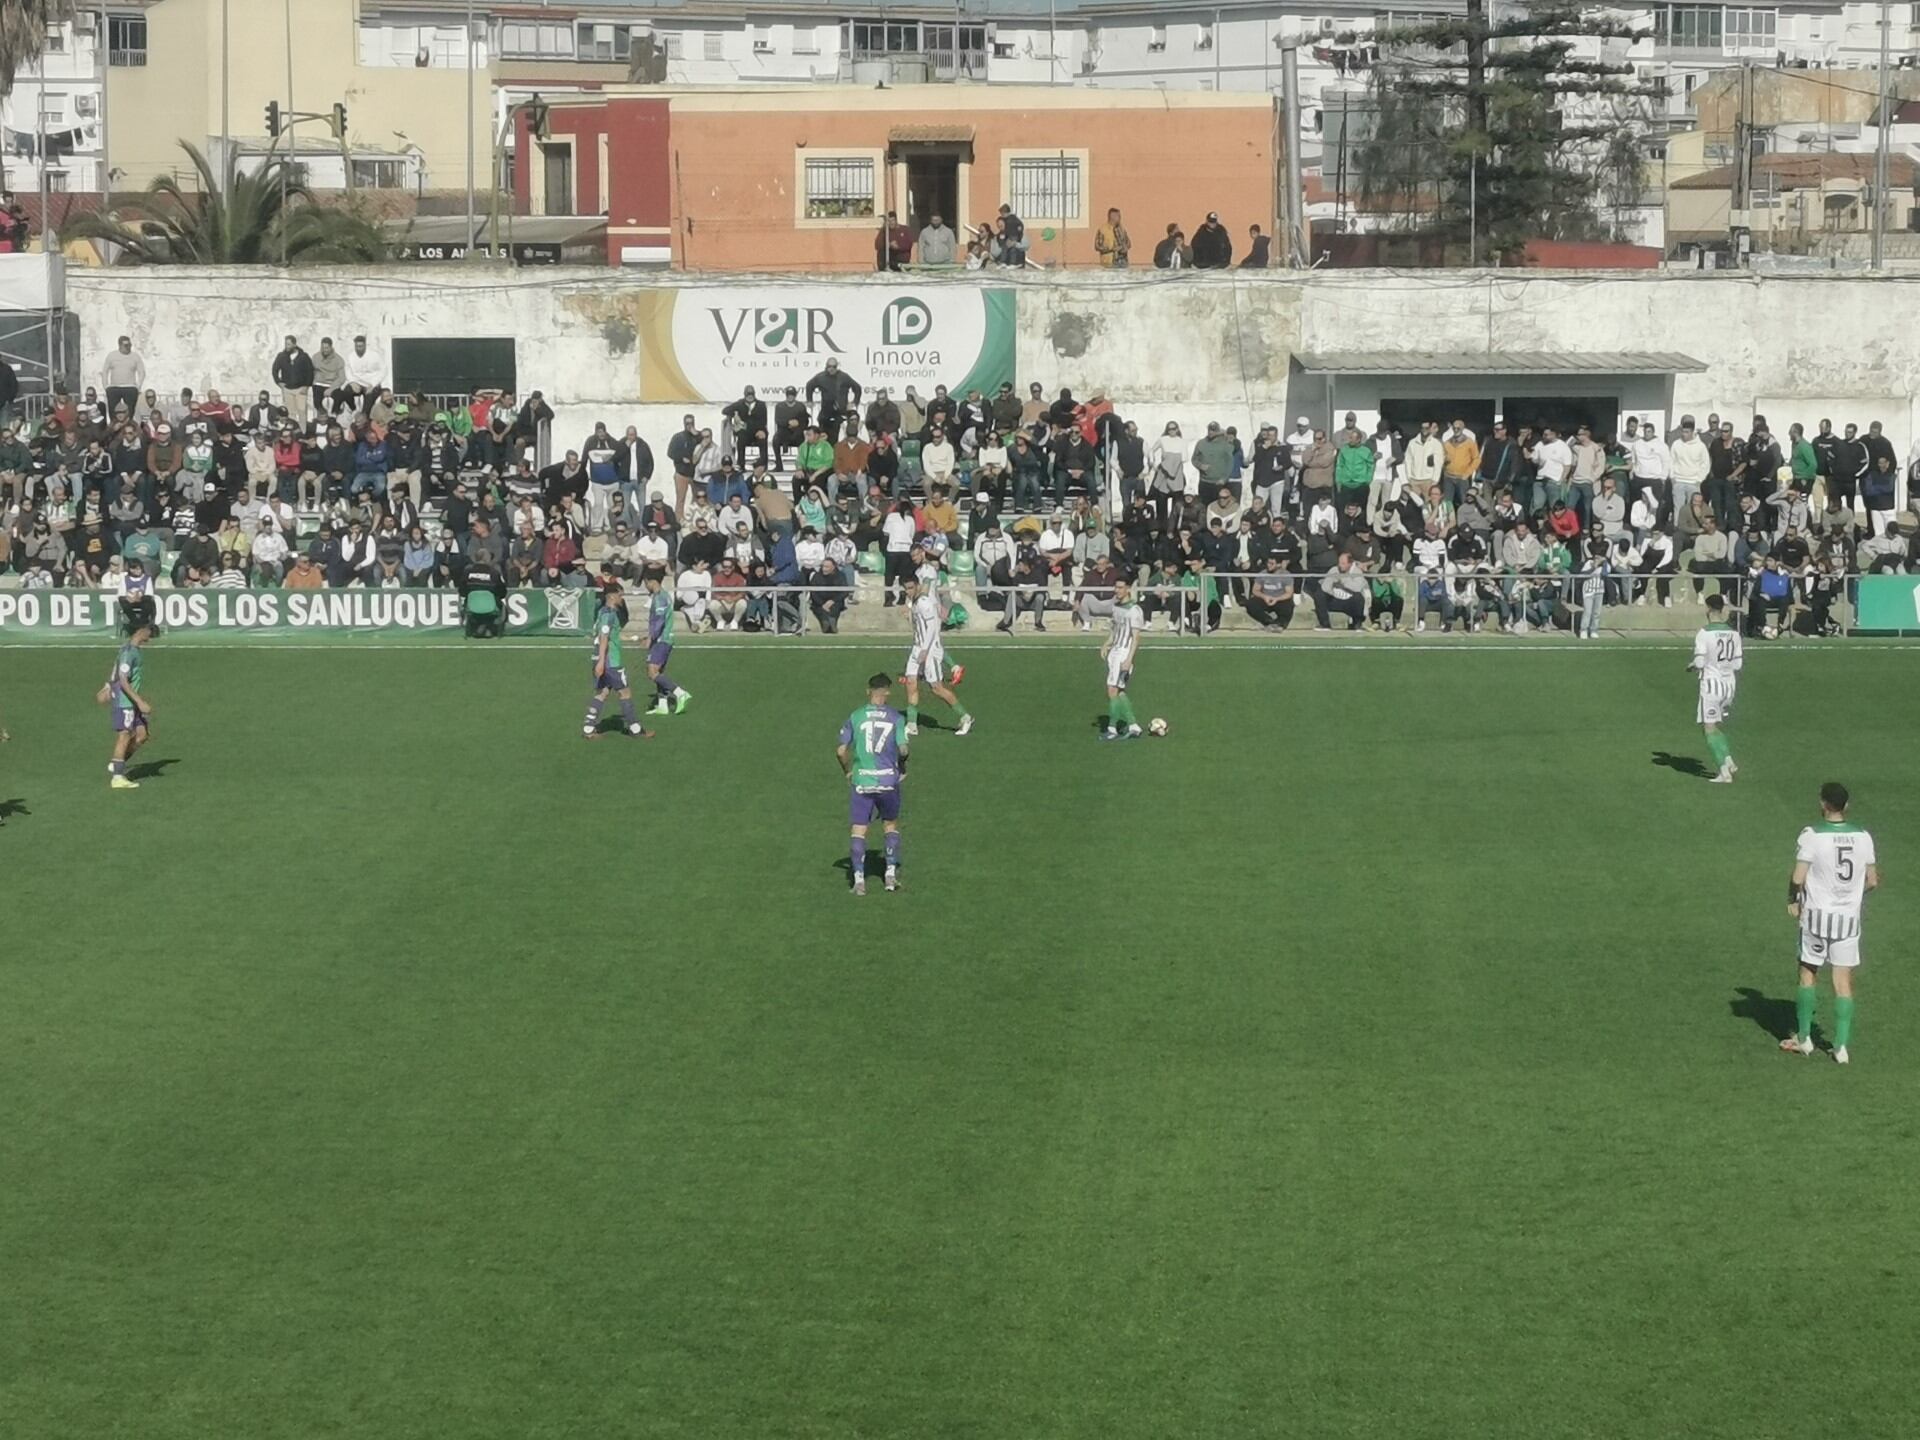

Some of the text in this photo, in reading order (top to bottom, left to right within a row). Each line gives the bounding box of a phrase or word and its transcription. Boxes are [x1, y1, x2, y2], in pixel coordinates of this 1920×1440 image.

[419, 247, 507, 259] LOS ANELS
[722, 355, 842, 369] Consultors
[866, 347, 941, 365] Innova
[870, 366, 936, 379] Prevención
[50, 593, 92, 626] DE
[99, 593, 209, 626] TDOS
[218, 593, 279, 626] LOS
[287, 593, 529, 628] SANLUQUES
[1717, 638, 1735, 662] 20
[860, 721, 894, 754] 17
[1835, 846, 1854, 882] 5
